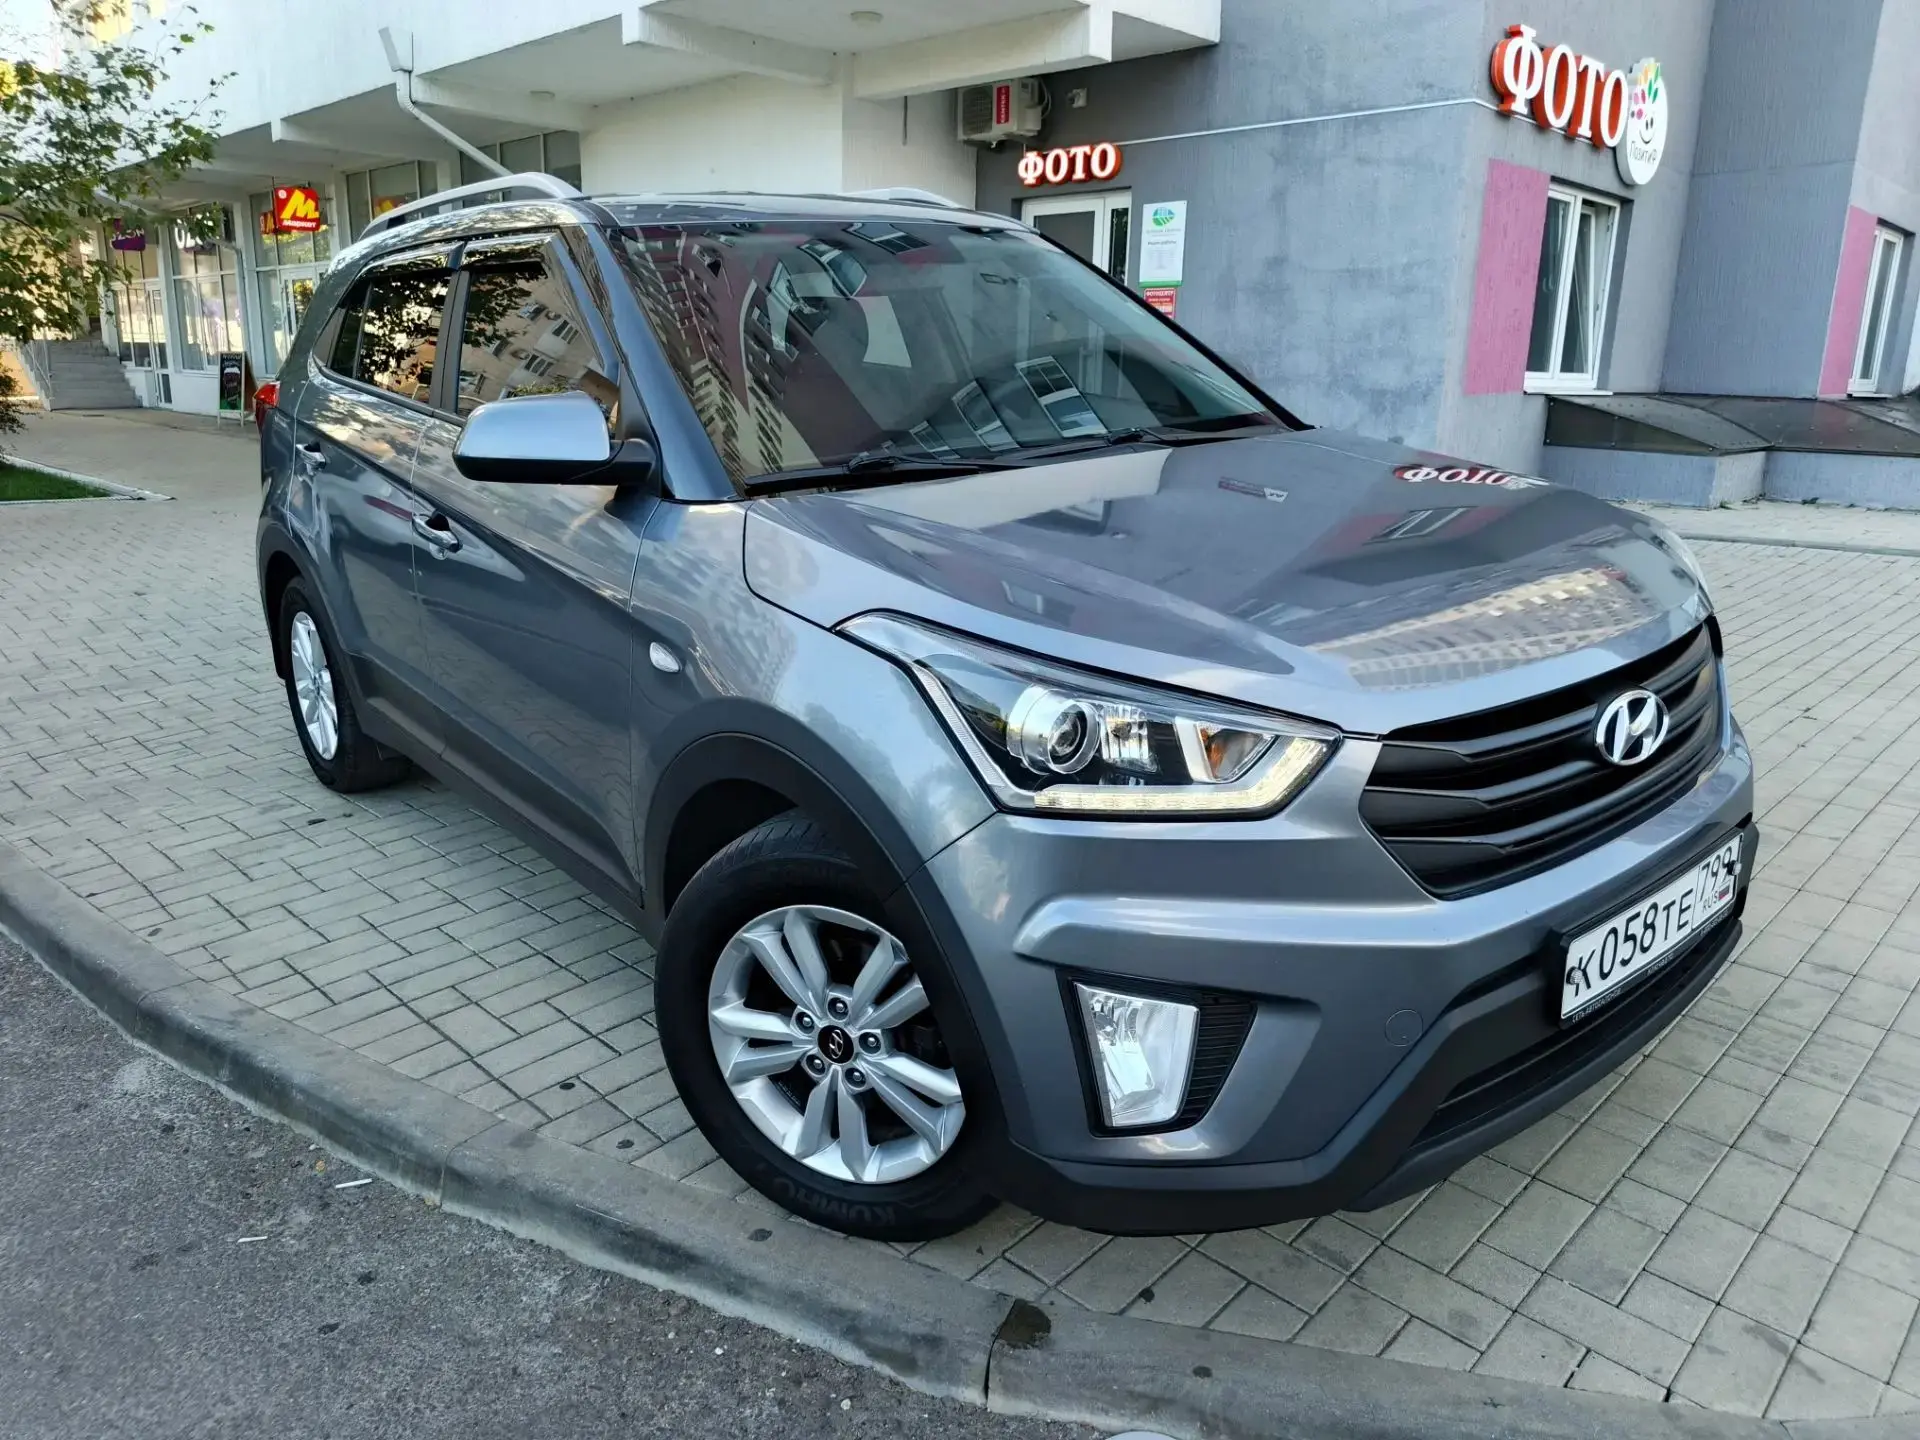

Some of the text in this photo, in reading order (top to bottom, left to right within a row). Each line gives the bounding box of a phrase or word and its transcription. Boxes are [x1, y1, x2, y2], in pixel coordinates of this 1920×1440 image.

[1501, 24, 1629, 148] ФОТО
[1017, 141, 1119, 185] ФОТО
[1702, 889, 1719, 912] RUS
